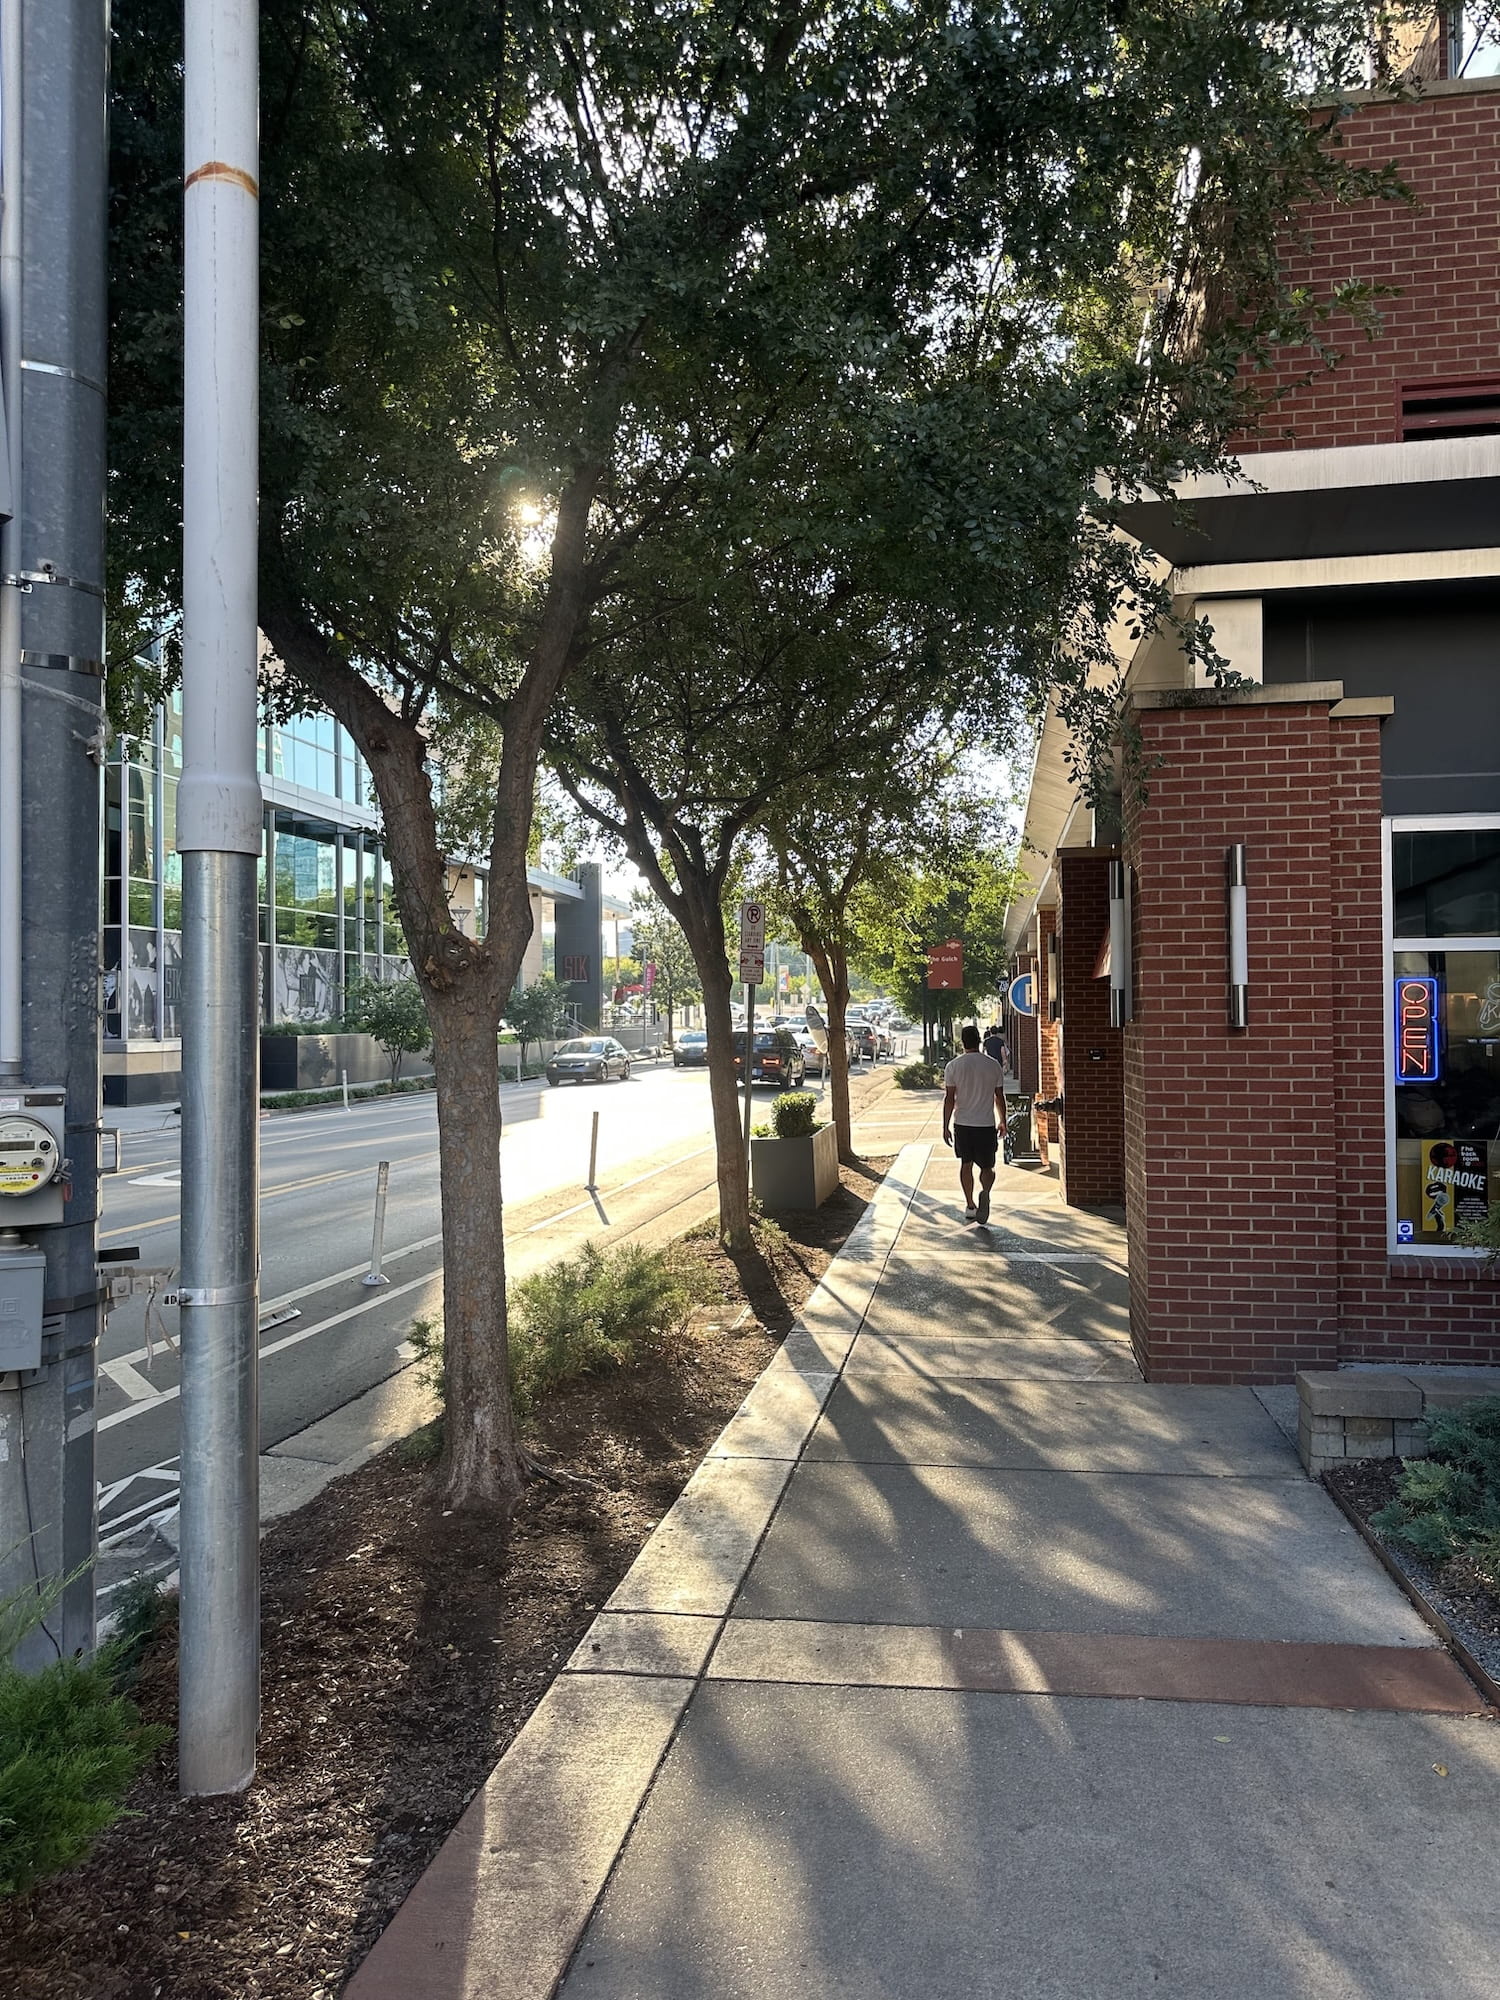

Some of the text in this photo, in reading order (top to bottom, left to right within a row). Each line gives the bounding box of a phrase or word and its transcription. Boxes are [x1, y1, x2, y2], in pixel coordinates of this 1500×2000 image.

[564, 956, 588, 979] STK
[165, 967, 183, 1000] STK
[1402, 983, 1428, 1074] OPEN
[1427, 1166, 1486, 1191] KARAOKE
